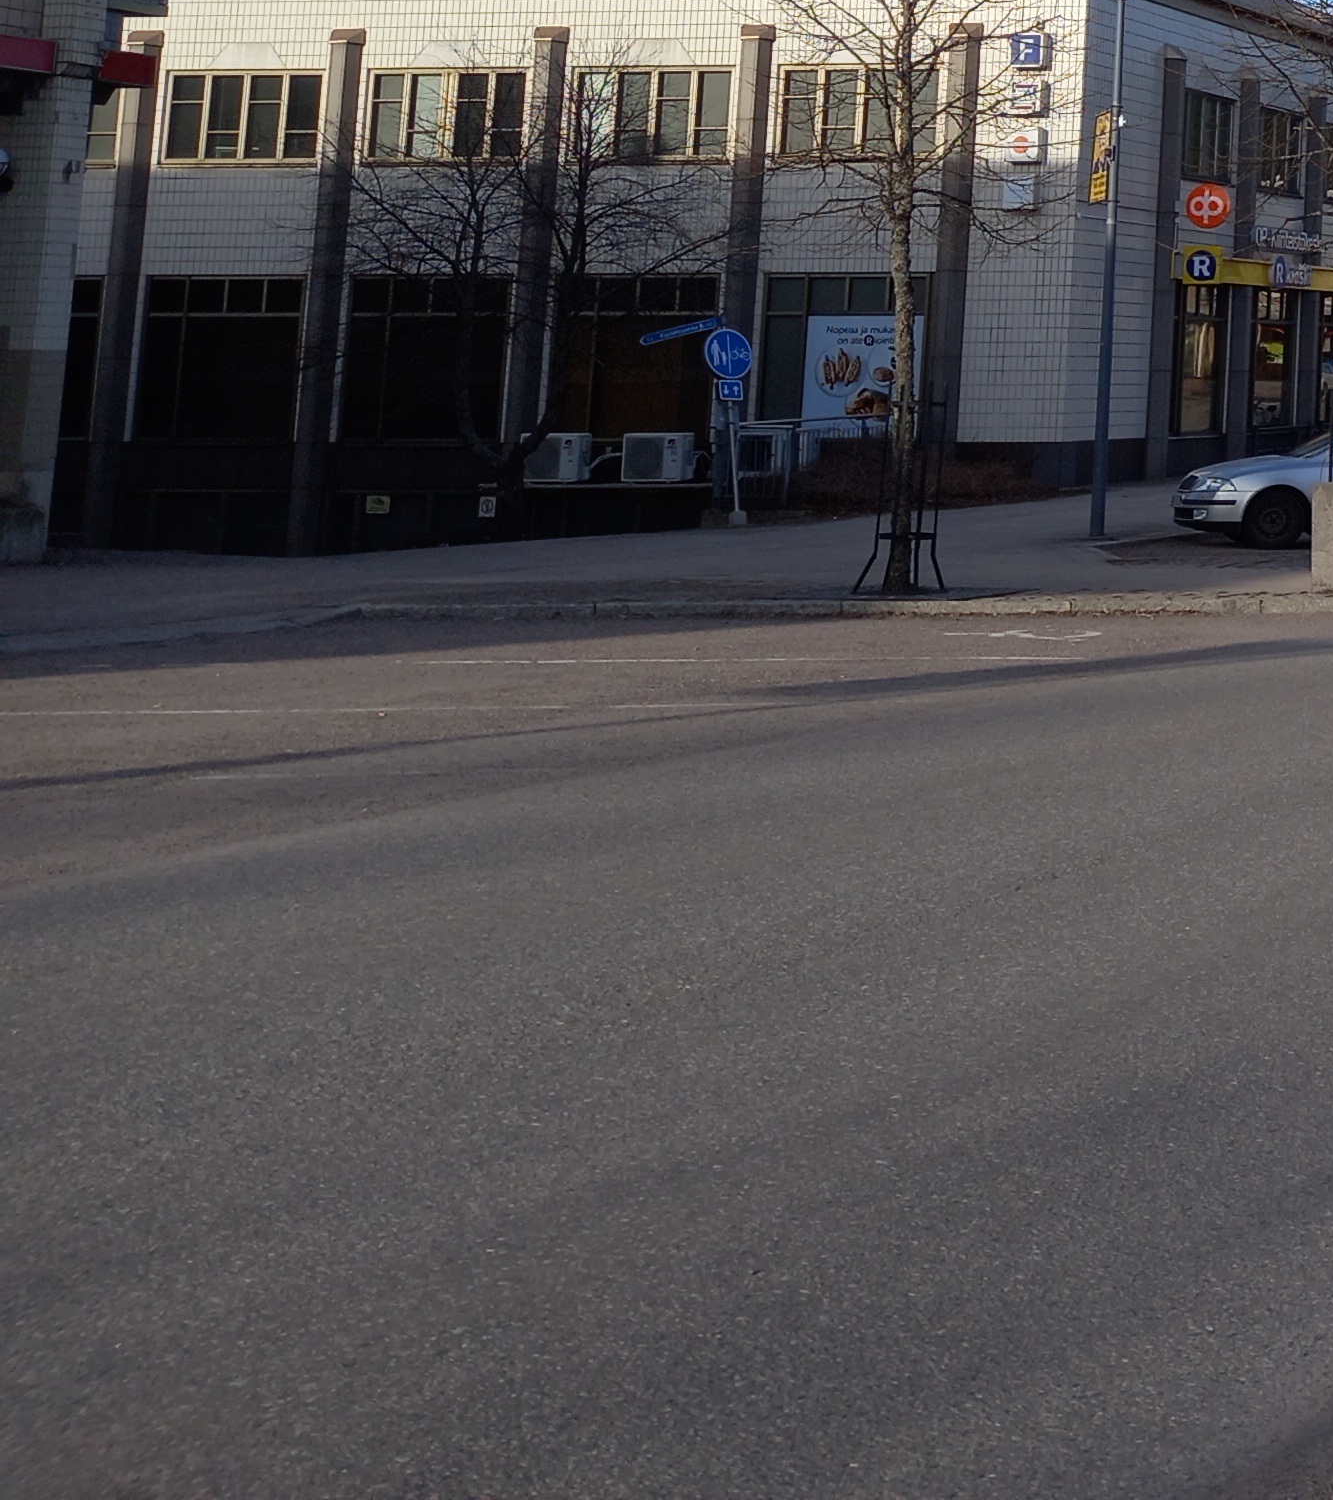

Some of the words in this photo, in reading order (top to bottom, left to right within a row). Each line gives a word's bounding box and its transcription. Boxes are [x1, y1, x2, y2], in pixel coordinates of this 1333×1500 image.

[1192, 256, 1211, 277] R
[826, 326, 858, 335] Nopeaa
[860, 326, 868, 335] ja
